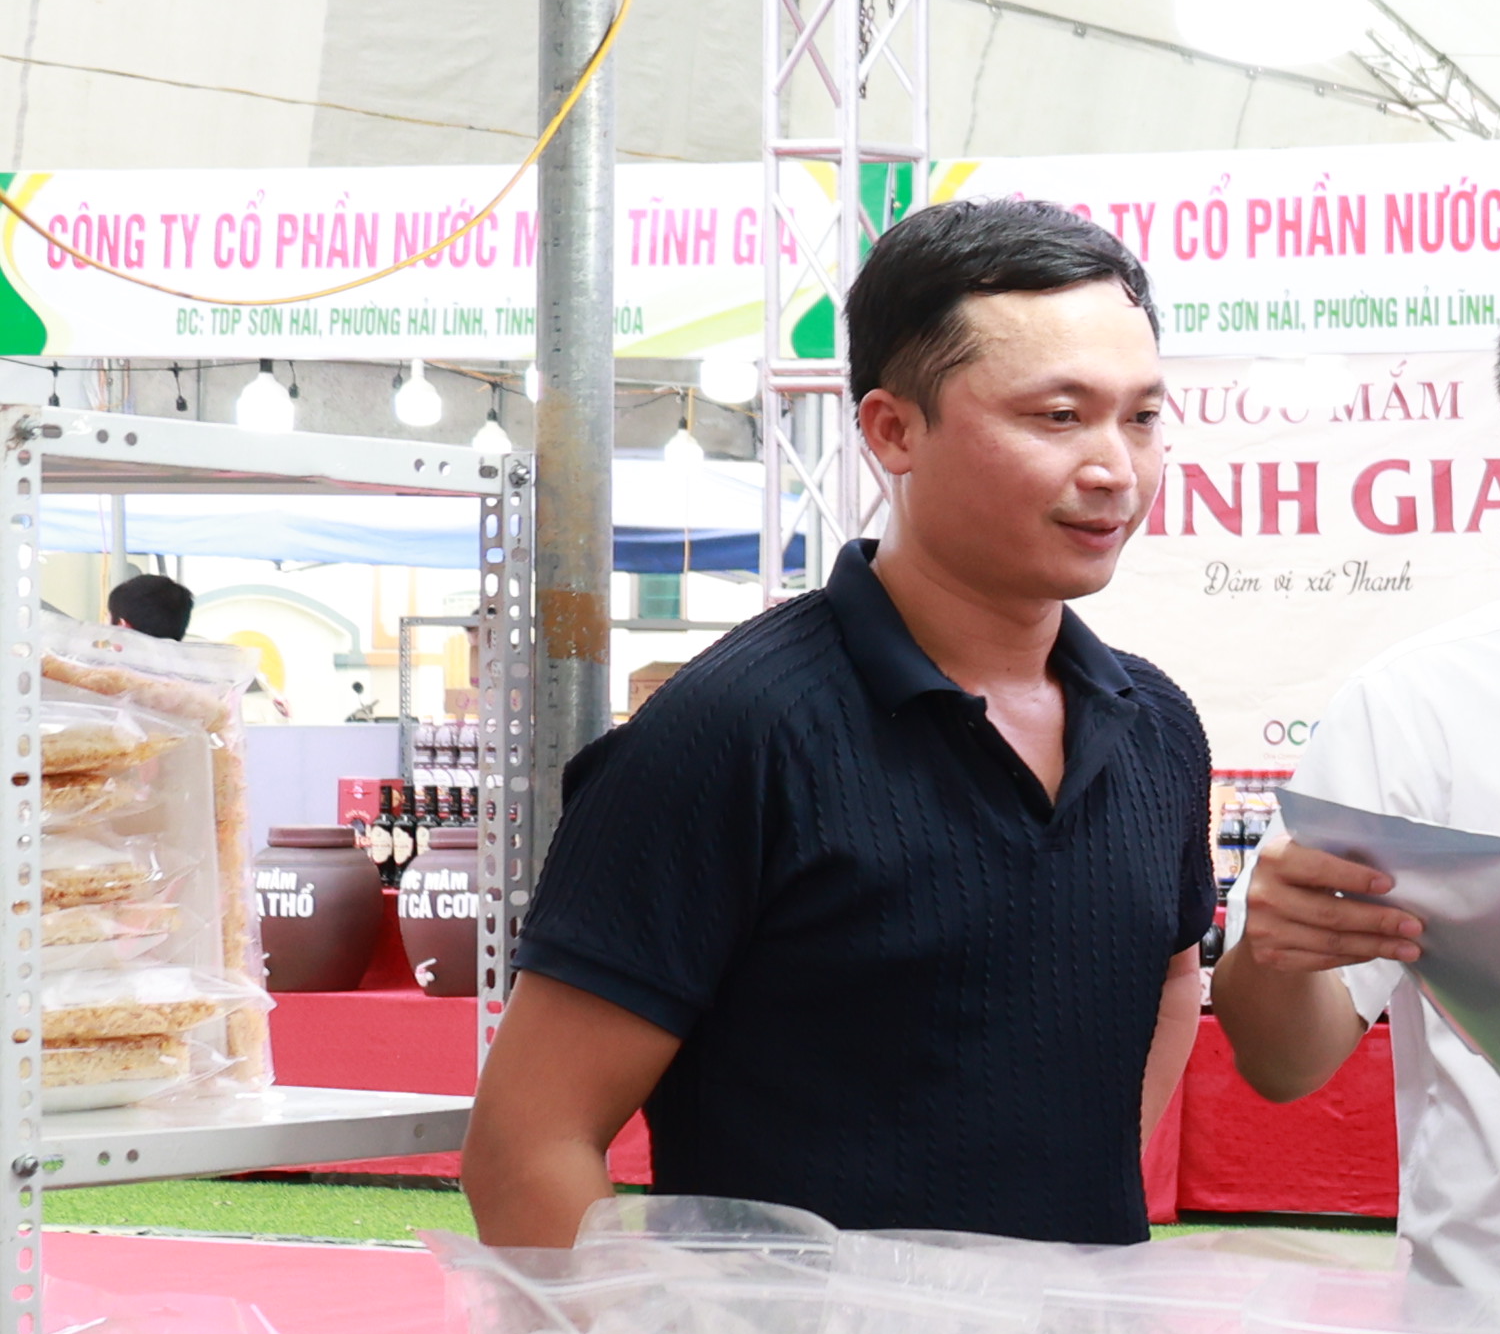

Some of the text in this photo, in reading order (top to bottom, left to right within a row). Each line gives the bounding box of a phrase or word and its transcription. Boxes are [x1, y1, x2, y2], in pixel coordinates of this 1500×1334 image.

[47, 201, 146, 271] CÔNG
[160, 213, 201, 269] TY
[213, 189, 267, 271] CỔ
[275, 191, 380, 269] PHẦN
[393, 199, 499, 269] NƯỚC
[628, 196, 718, 266] TĨNH
[1173, 173, 1232, 261] CỔ
[1247, 173, 1366, 260] PHẦN
[176, 307, 204, 336] ĐC:
[210, 308, 242, 335] TDP
[248, 305, 283, 335] SƠN
[329, 301, 401, 336] PHƯỜNG
[407, 298, 437, 335] HẢI
[443, 301, 487, 338] LĨNH,
[496, 298, 535, 335] TỈNH
[1173, 302, 1210, 333] TDP
[1218, 298, 1259, 333] SƠN
[1267, 289, 1305, 335] HẢI,
[1314, 291, 1397, 330] PHƯỜNG
[1405, 285, 1439, 327] HẢI
[1448, 288, 1500, 328] LĨNH,
[1204, 561, 1261, 597] Đậm
[1342, 560, 1413, 594] Thanh
